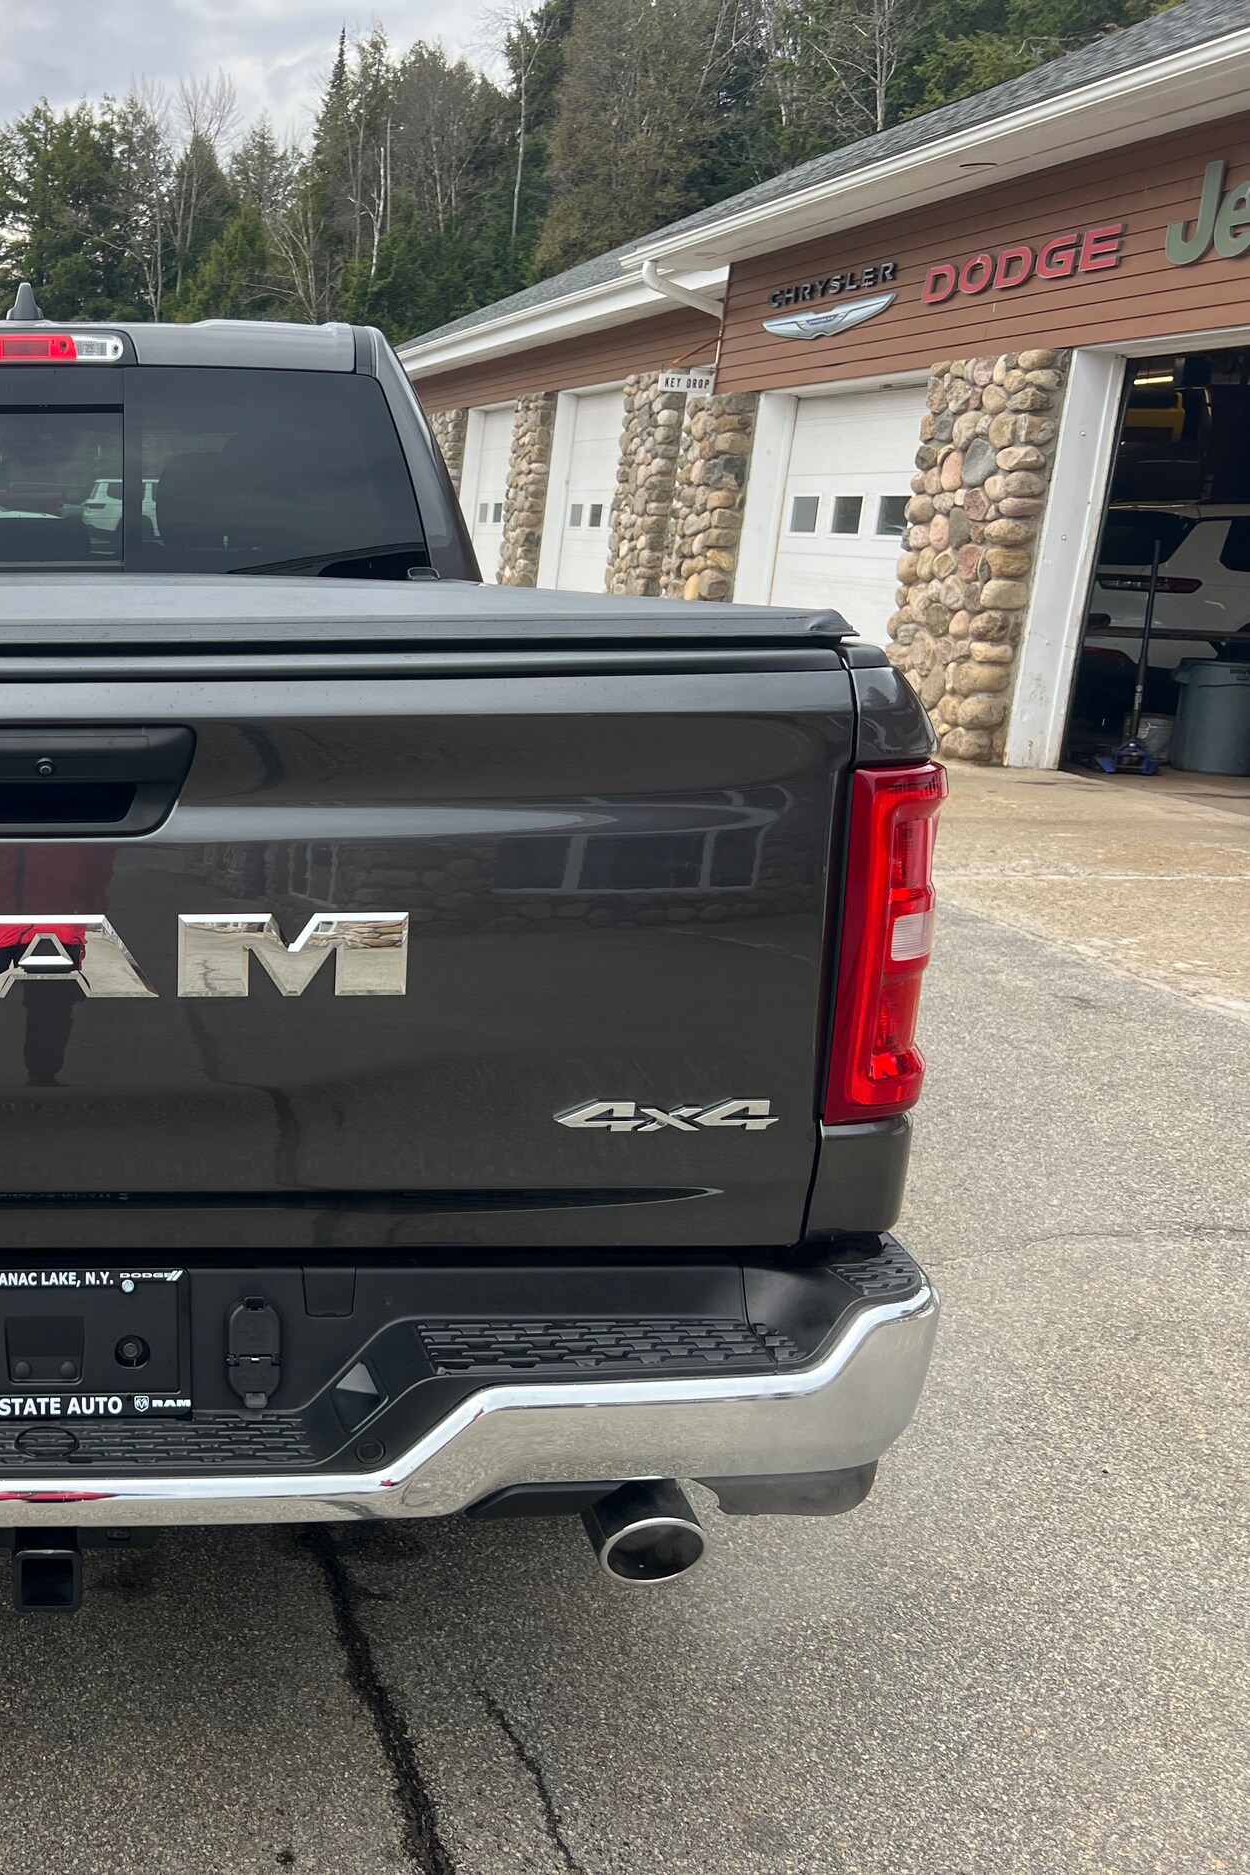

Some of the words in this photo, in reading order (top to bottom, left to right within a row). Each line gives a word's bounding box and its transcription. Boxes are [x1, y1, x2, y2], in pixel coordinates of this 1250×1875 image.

[922, 223, 1127, 304] DODGE
[768, 262, 897, 308] CHRYSLER
[664, 377, 681, 388] KEY
[686, 378, 710, 389] DROP
[41, 1271, 81, 1288] LAKE,
[85, 1271, 114, 1285] N.Y.
[67, 1396, 123, 1415] AUTO
[151, 1399, 192, 1408] RAM
